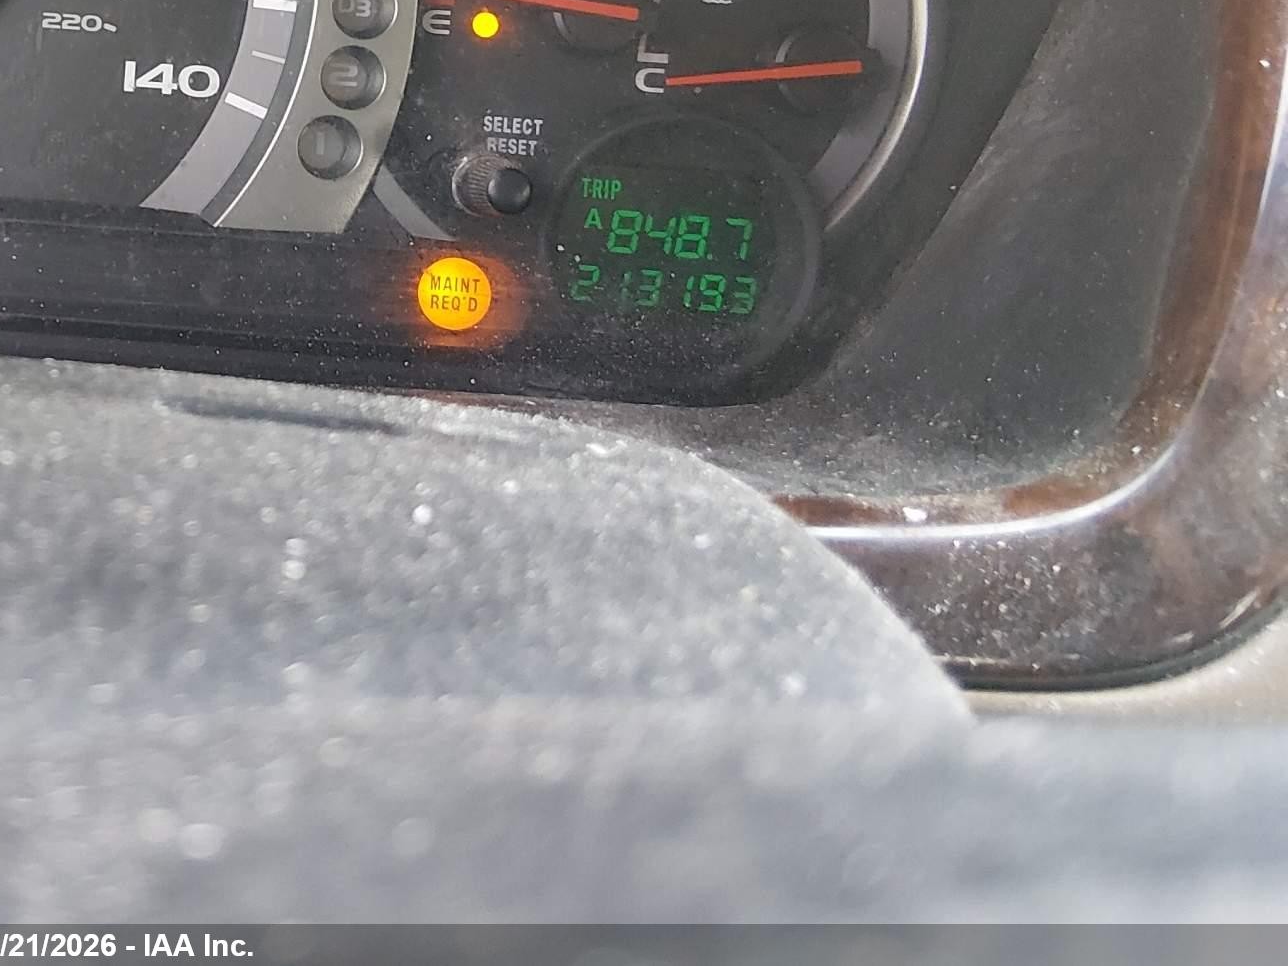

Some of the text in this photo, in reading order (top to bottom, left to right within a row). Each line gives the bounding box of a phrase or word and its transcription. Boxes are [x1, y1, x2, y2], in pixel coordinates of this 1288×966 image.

[41, 12, 102, 32] 220
[123, 60, 220, 98] 140
[328, 60, 359, 88] 2
[634, 67, 666, 94] C
[482, 114, 544, 136] SELECT
[486, 136, 538, 156] RESET
[581, 177, 622, 200] TRIP
[583, 207, 754, 261] A 848.7
[430, 274, 481, 293] MAINT
[567, 263, 758, 315] 213193
[430, 294, 478, 312] REQ'D
